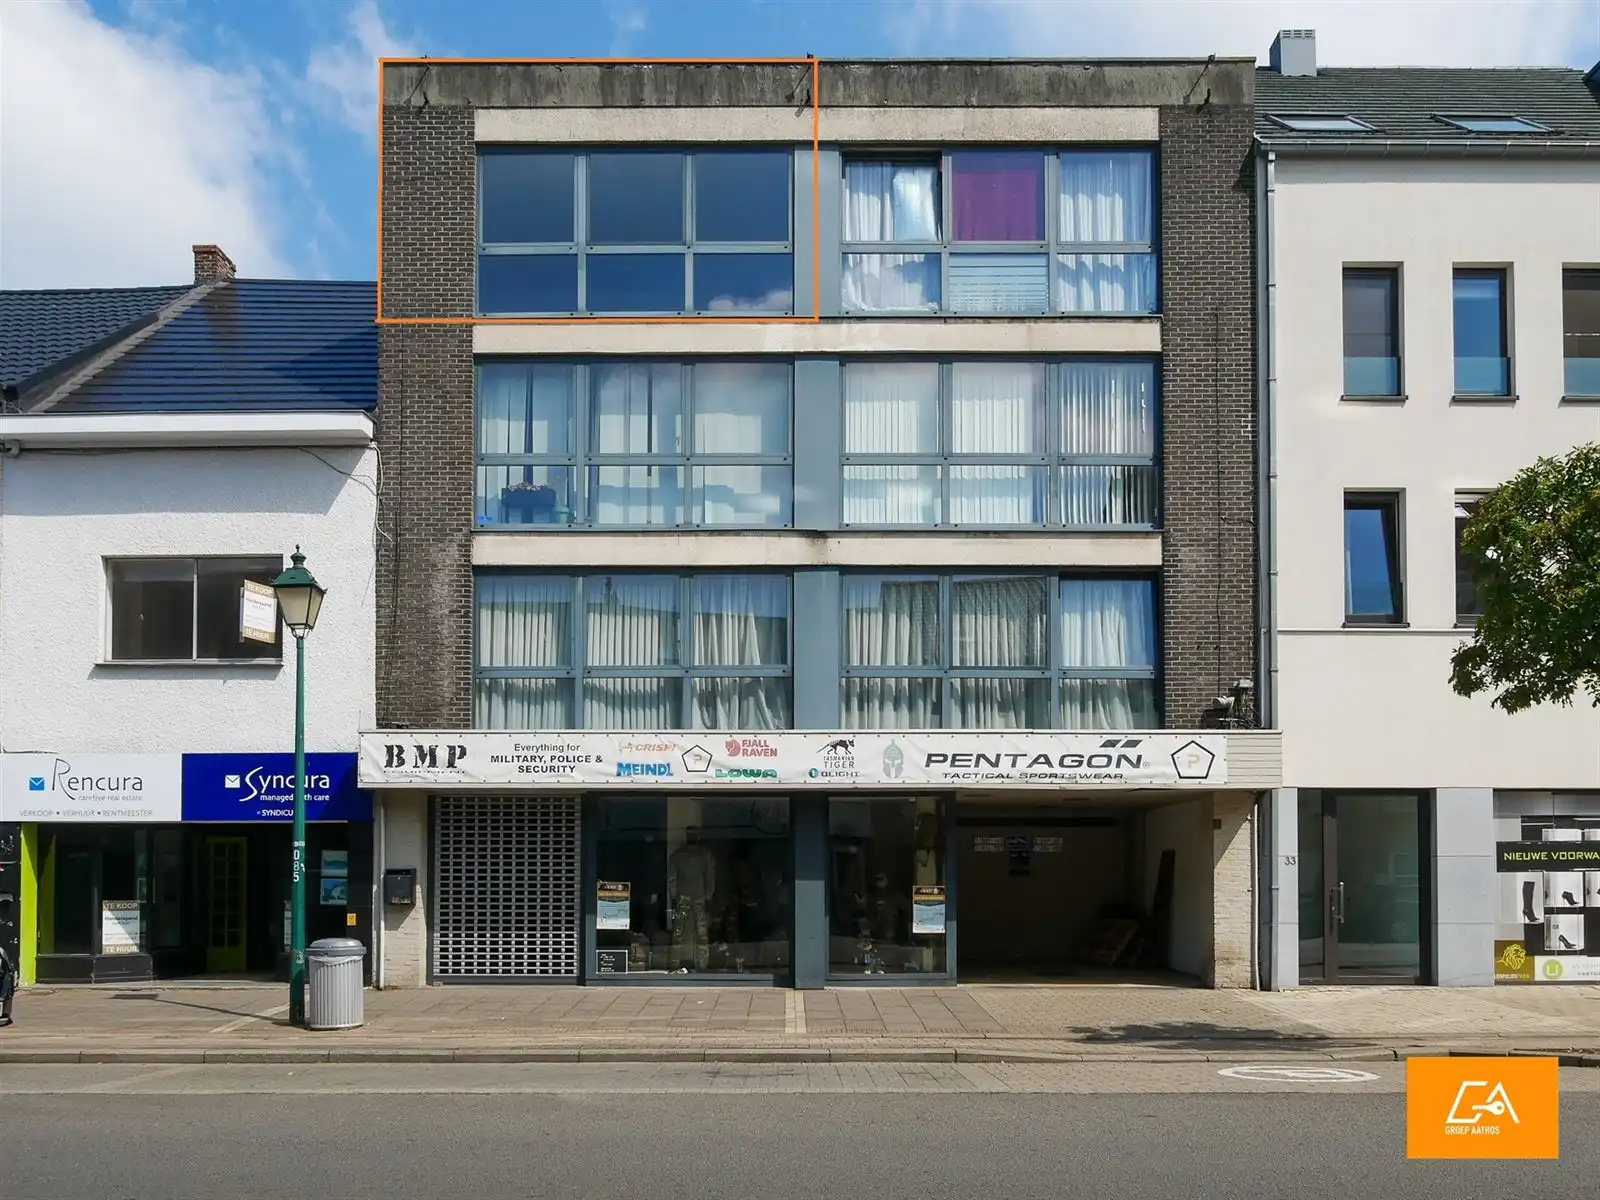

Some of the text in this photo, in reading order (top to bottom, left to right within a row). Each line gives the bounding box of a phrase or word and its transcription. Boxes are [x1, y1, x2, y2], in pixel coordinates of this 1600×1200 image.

[514, 743, 580, 753] Everything for
[742, 748, 778, 757] RAVEN
[490, 755, 603, 764] MILITARY, POLICE &
[924, 753, 1143, 769] PENTAGON
[518, 765, 576, 774] SECURITY
[616, 761, 674, 776] MEINDL
[715, 768, 778, 778] LOWA
[52, 758, 143, 801] Rencura
[942, 772, 1124, 780] TACTICAL SPORTSWEAR
[260, 794, 294, 803] managed
[19, 809, 153, 817] VERKOOP VERHUUR RENTMEESTER
[261, 809, 294, 817] SYNDICU
[1503, 851, 1548, 861] NIEUWE
[1284, 856, 1297, 866] 33
[117, 902, 138, 910] KOOP
